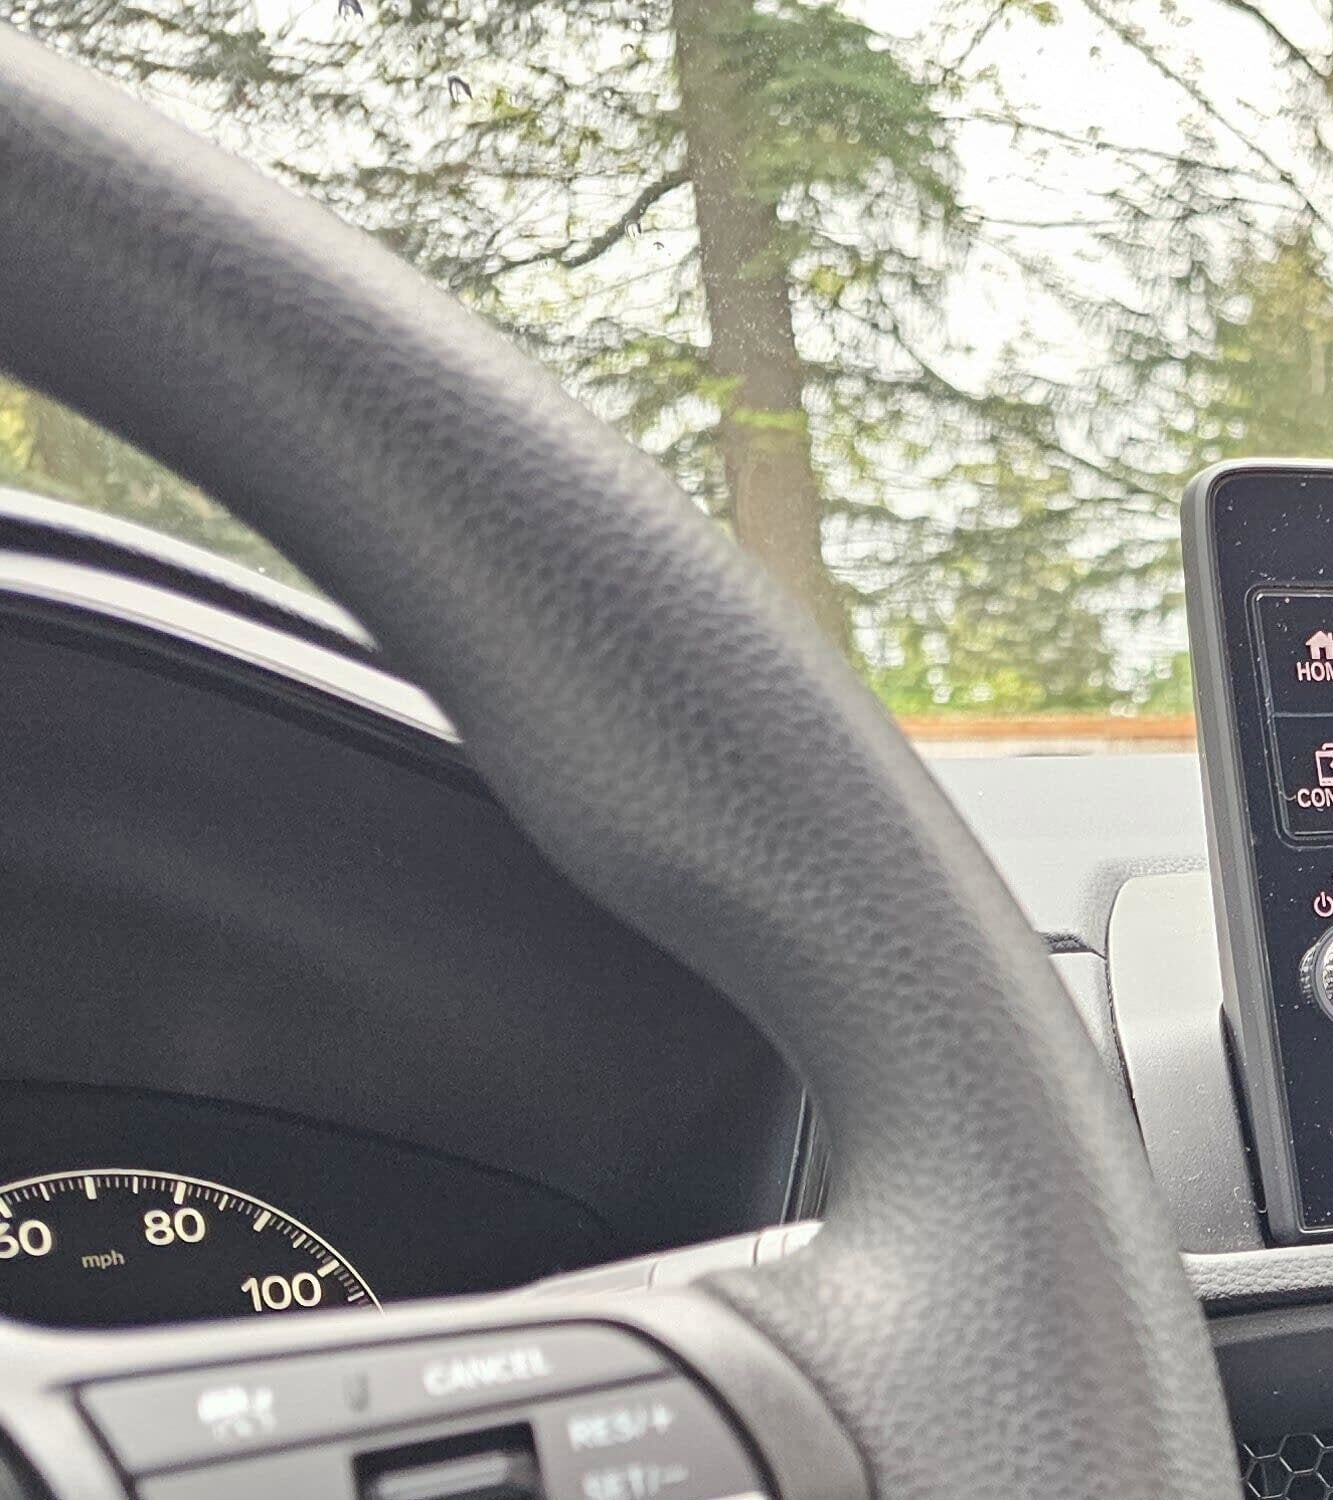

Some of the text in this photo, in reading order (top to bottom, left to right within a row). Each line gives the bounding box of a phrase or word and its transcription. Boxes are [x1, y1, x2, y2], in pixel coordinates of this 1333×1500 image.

[144, 1207, 206, 1247] 80
[81, 1249, 126, 1269] mph
[241, 1272, 322, 1312] 100
[423, 1345, 550, 1397] CANCEL
